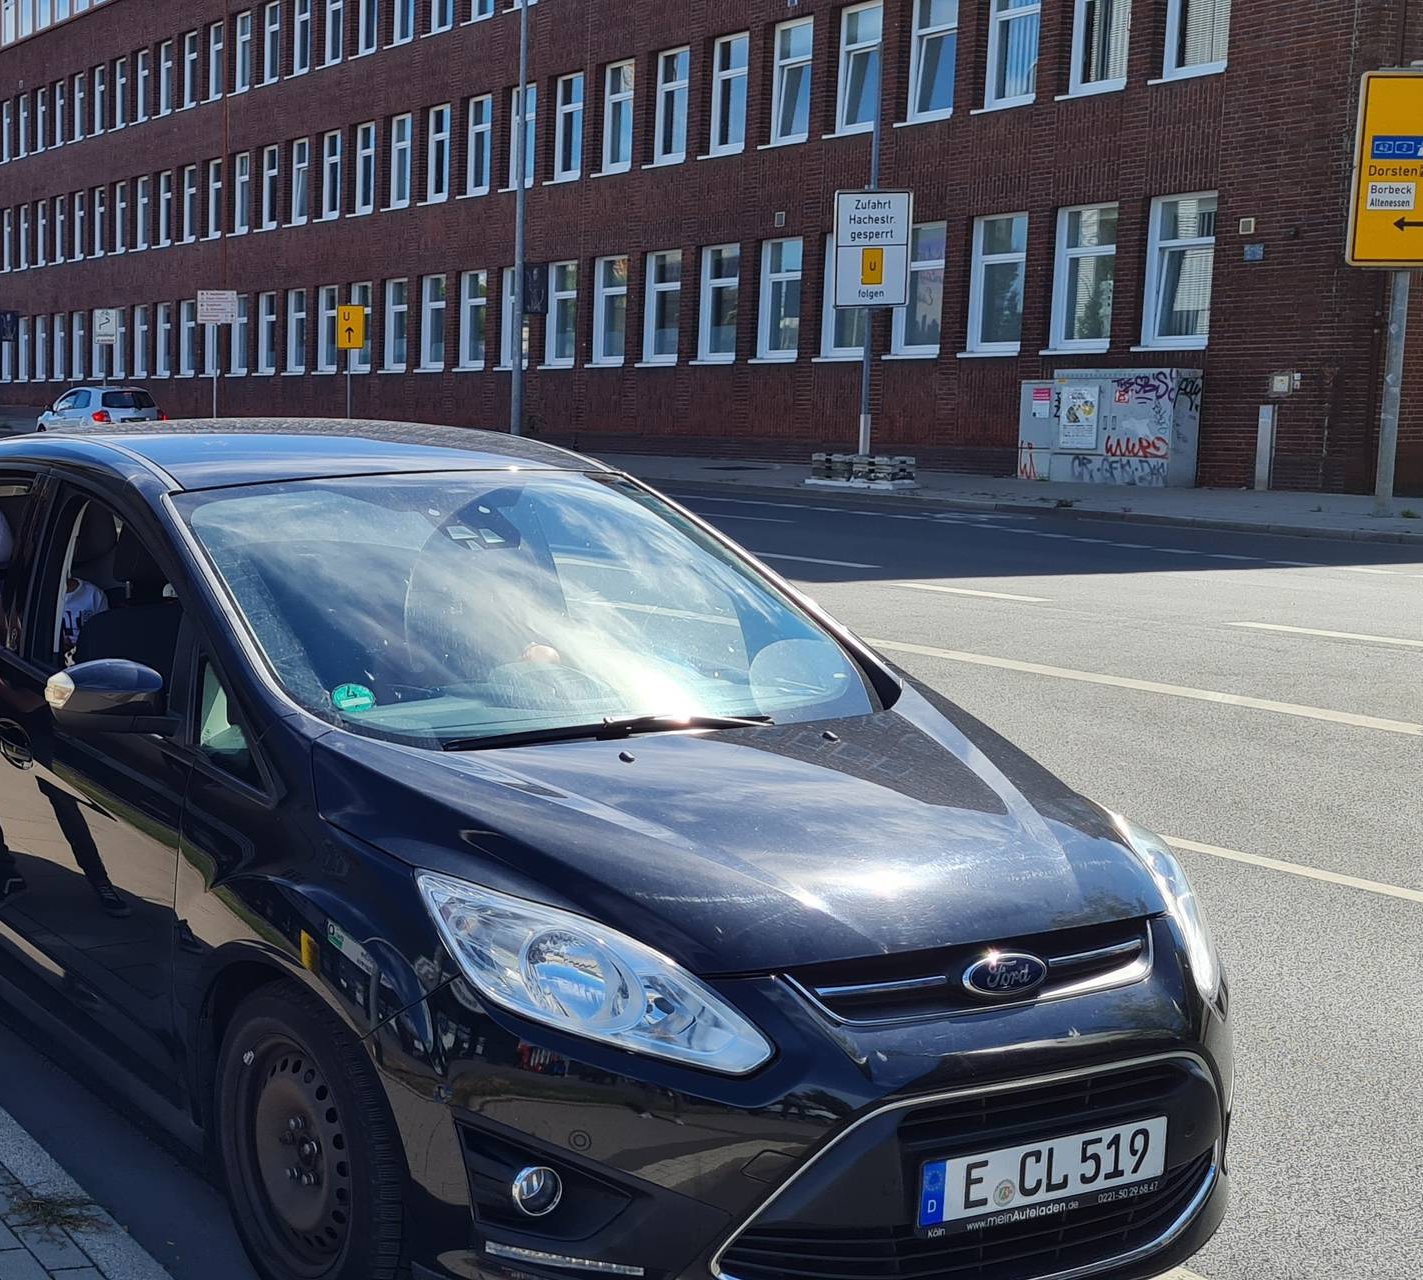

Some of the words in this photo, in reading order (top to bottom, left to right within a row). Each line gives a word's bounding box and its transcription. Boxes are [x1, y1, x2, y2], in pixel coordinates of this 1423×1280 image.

[1368, 164, 1418, 177] Dorsten
[1370, 184, 1412, 195] Borbeck
[855, 199, 891, 210] Zufahrt
[1370, 197, 1410, 208] Altenessen
[848, 214, 897, 225] Hachestr.
[850, 229, 894, 242] gesperrt
[869, 261, 877, 272] U
[858, 289, 885, 300] folgen
[343, 311, 350, 322] U
[987, 960, 1031, 989] Ford
[963, 1159, 989, 1210] E
[1018, 1146, 1069, 1198] CL
[1079, 1127, 1151, 1185] 519
[927, 1199, 937, 1214] D
[928, 1226, 946, 1239] Köln
